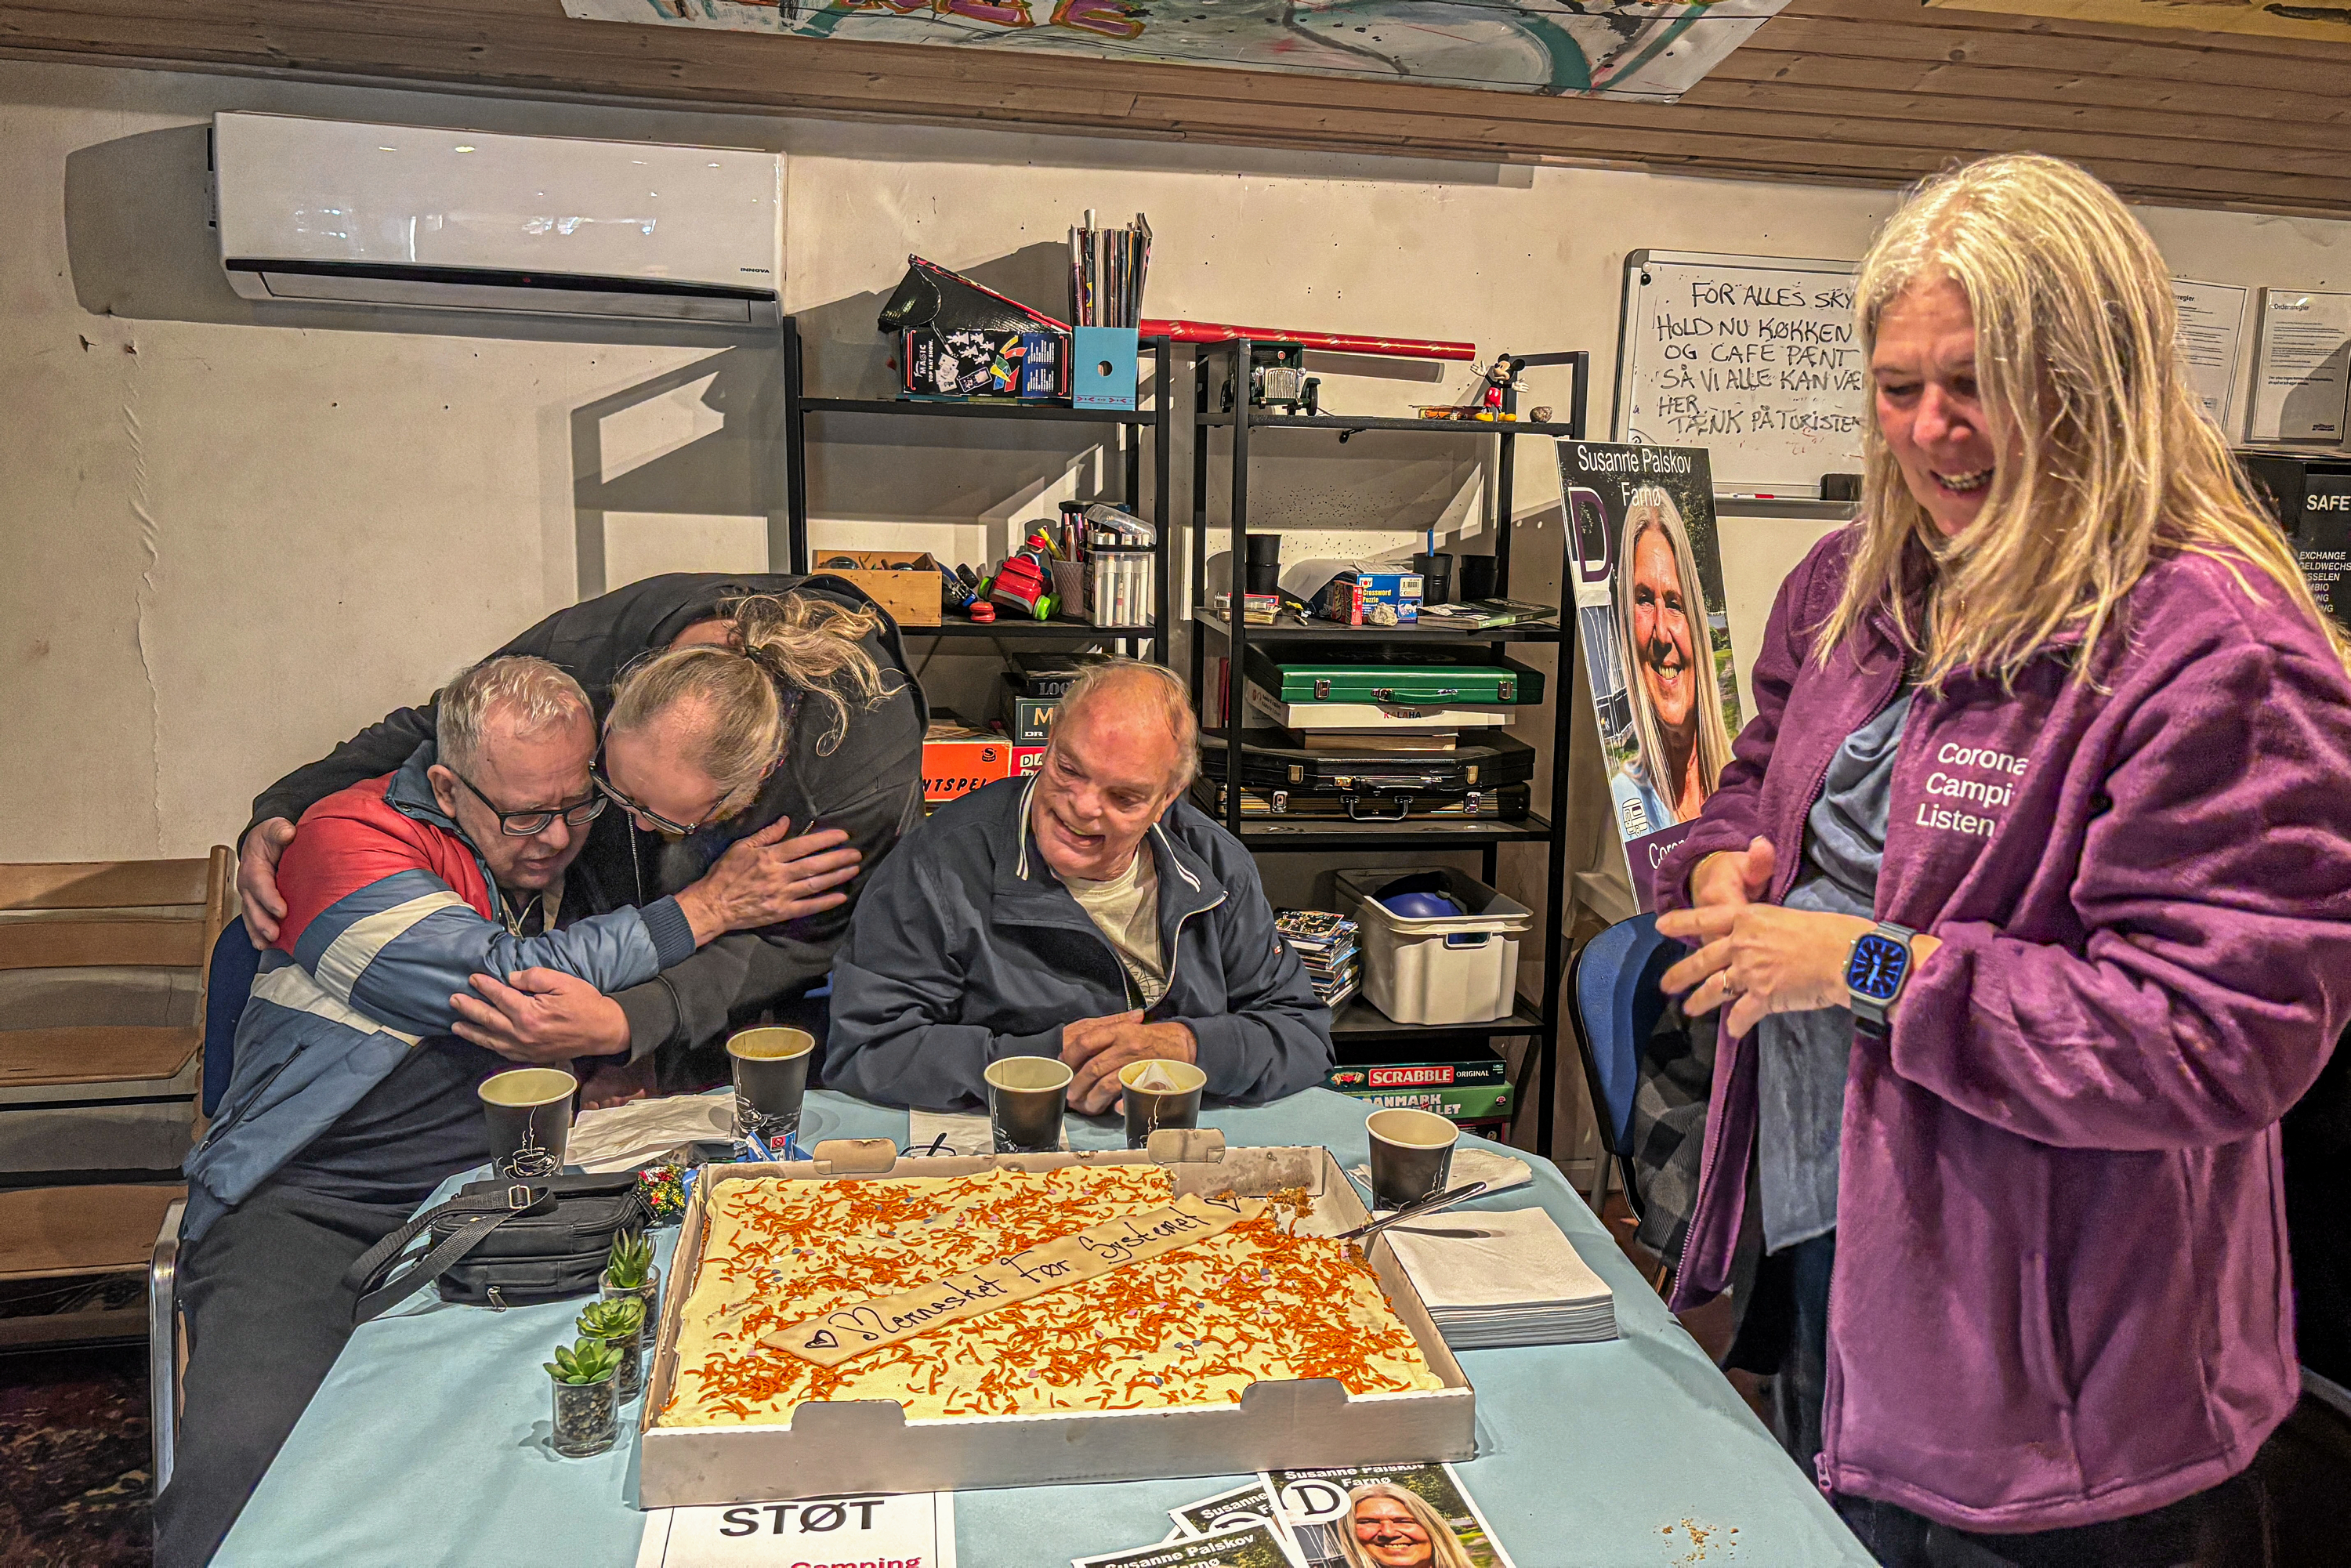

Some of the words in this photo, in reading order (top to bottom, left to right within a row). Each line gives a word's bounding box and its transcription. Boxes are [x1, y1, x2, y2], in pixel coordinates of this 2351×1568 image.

[1691, 282, 1734, 307] FOR
[1744, 284, 1806, 307] ALLES
[1657, 313, 1713, 342] HOLD
[1720, 318, 1748, 337] NU
[1665, 344, 1697, 361] OG
[1661, 364, 1694, 389] SÅ
[1701, 369, 1719, 392] VI
[1726, 368, 1771, 391] ALLE
[1780, 370, 1828, 391] KAN
[1668, 409, 1744, 436] TÆNK
[1751, 404, 1775, 433] PÅ
[1578, 444, 1639, 473] Susanne
[1642, 447, 1691, 474] Palskov
[1621, 481, 1661, 507] Farnø
[2306, 494, 2351, 511] SAFE
[2299, 551, 2346, 559] EXCHANGE
[1938, 743, 2028, 775] Corona
[1926, 773, 2012, 808] Campi
[1916, 803, 1995, 838] Listen
[1372, 1068, 1451, 1084] SCRABBLE
[828, 1274, 1008, 1341] Mennesket
[1079, 1205, 1211, 1265] Systemet
[1285, 1468, 1357, 1479] Susanne
[1341, 1476, 1391, 1487] Farnø
[1201, 1492, 1268, 1519] Susanne
[1291, 1485, 1340, 1515] D
[719, 1500, 885, 1537] STØT
[1185, 1534, 1255, 1558] Palskov
